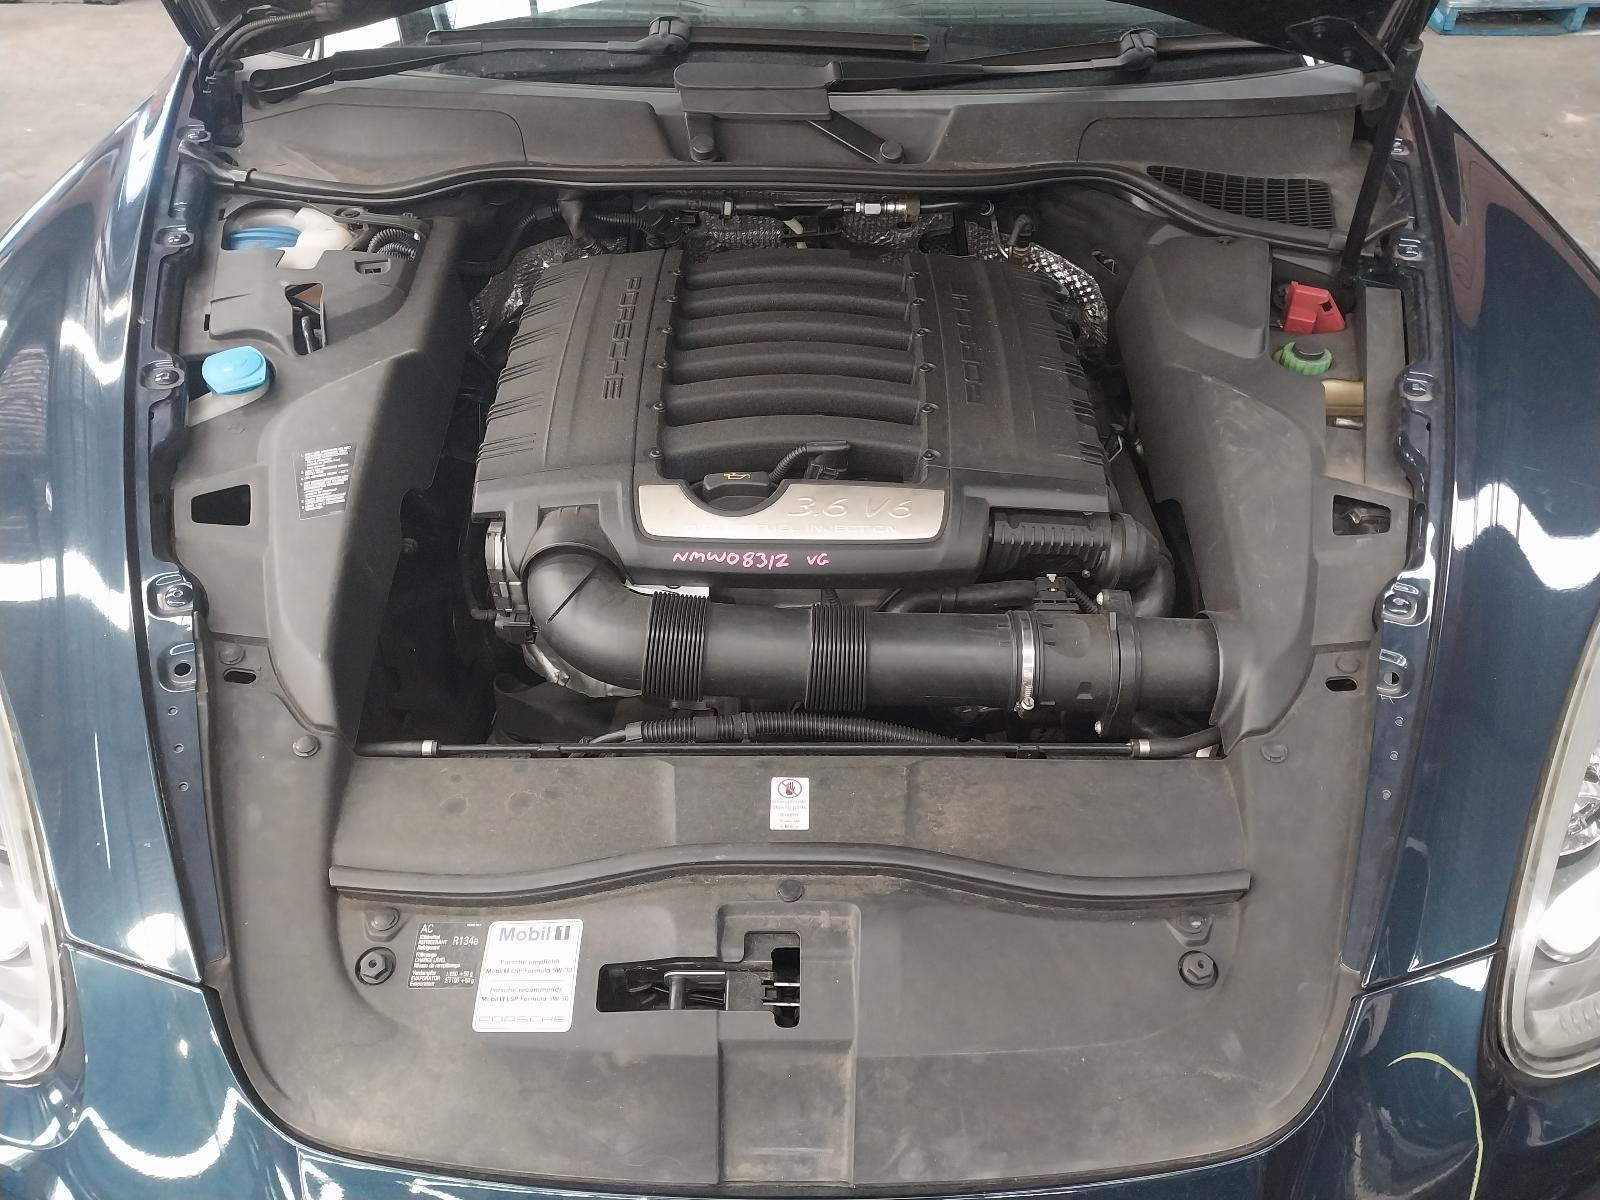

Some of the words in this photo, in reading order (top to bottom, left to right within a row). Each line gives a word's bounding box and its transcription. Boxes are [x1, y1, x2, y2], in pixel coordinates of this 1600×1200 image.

[601, 277, 641, 400] PORSCHE
[787, 496, 849, 518] 3.6
[865, 496, 914, 519] V6
[420, 923, 434, 934] AC
[500, 926, 551, 942] Mobil
[452, 935, 479, 946] R134a
[478, 1015, 567, 1024] PORSCHE
